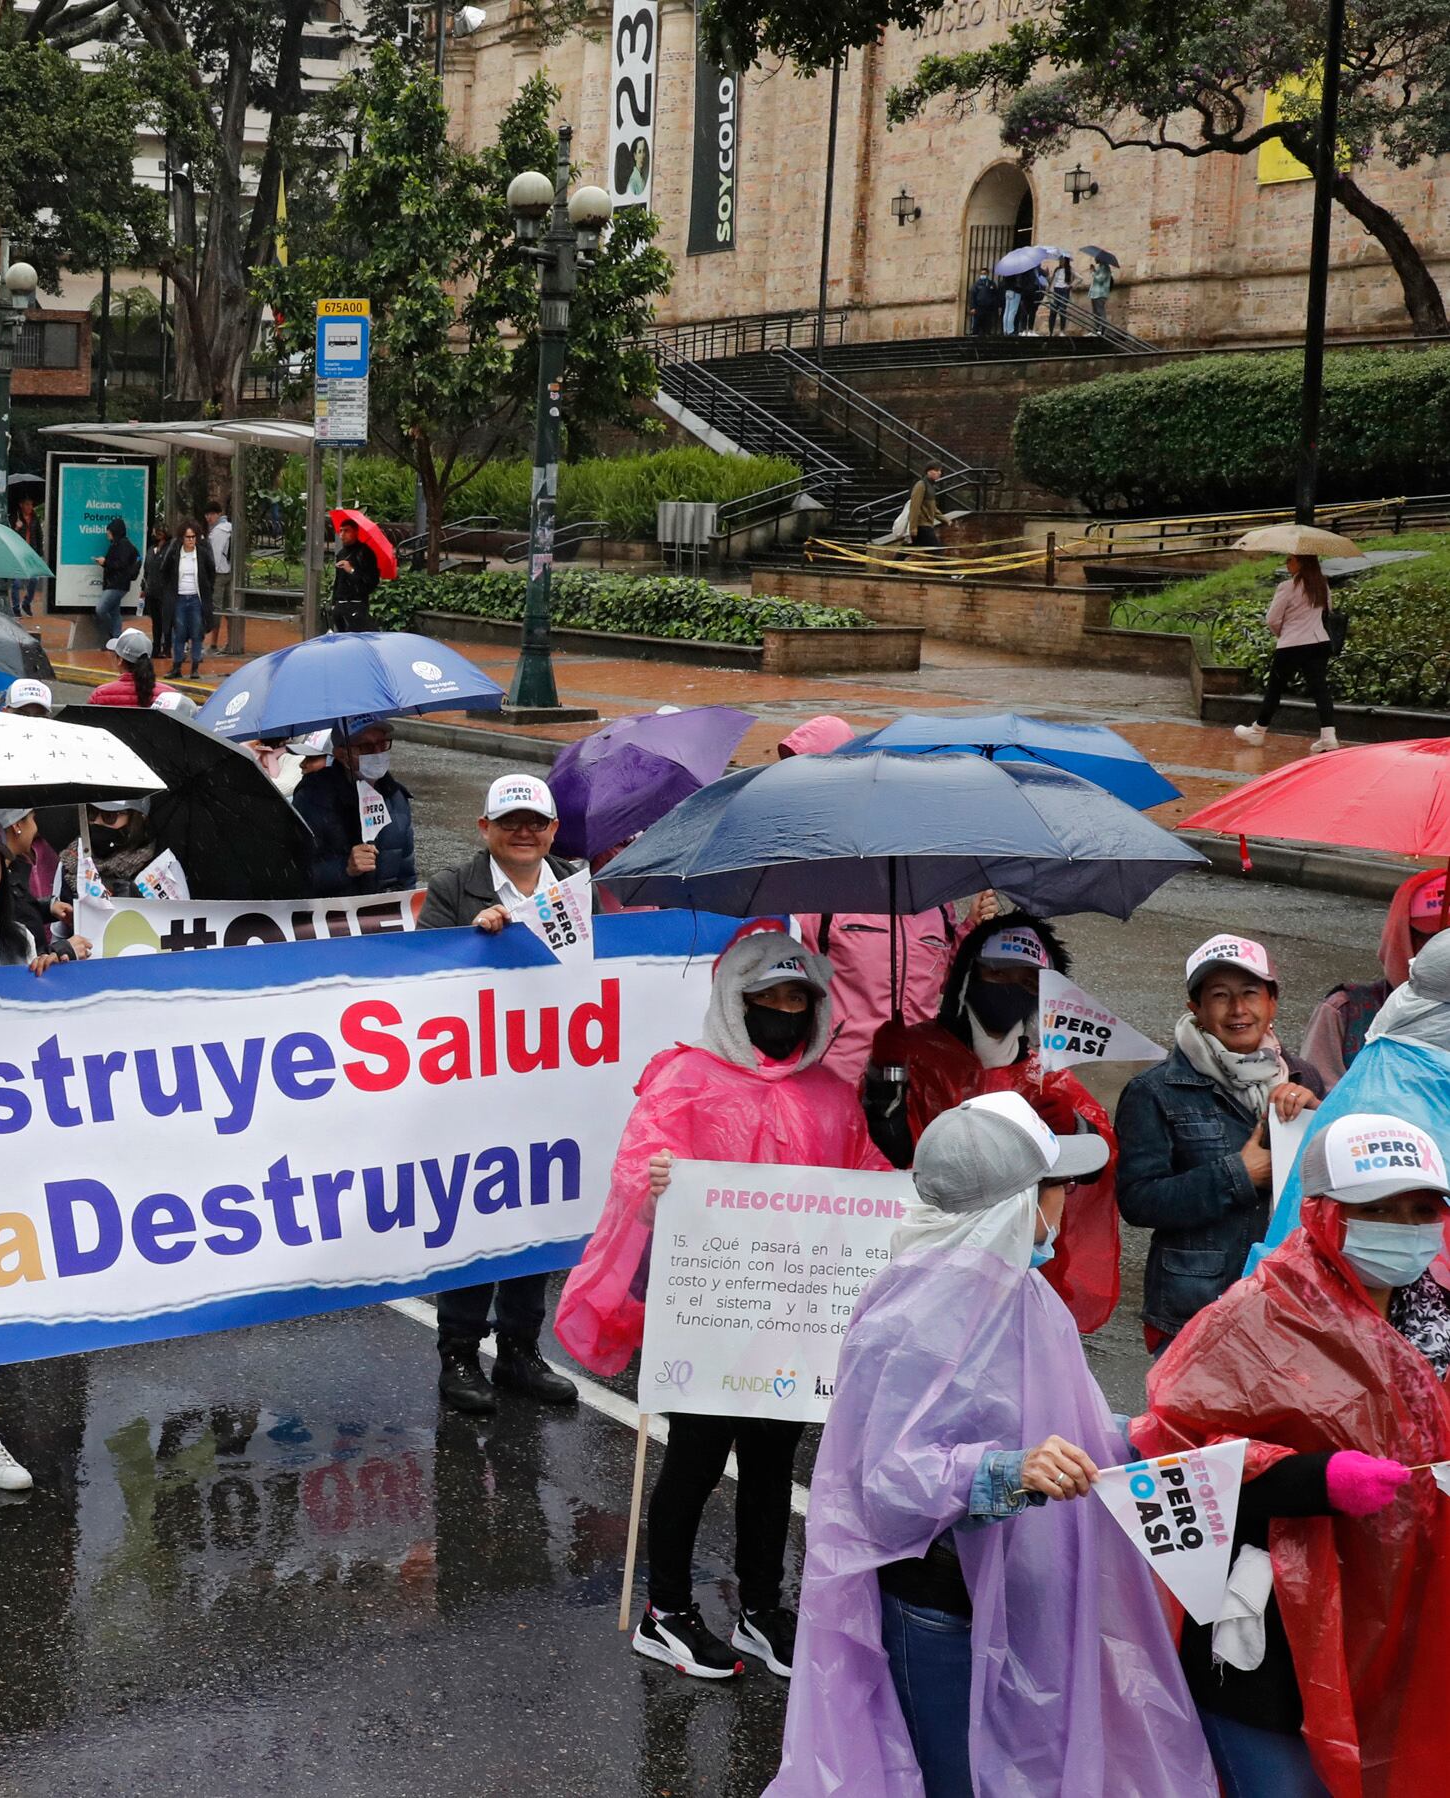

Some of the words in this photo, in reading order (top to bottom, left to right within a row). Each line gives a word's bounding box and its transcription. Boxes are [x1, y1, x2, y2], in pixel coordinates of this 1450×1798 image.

[612, 8, 653, 214] 823
[716, 76, 734, 242] SOYCOLO
[324, 302, 362, 313] 675A00
[85, 500, 122, 510] Alcance
[1045, 999, 1118, 1026] REFORMA
[1347, 1129, 1415, 1144] #REFORMA
[705, 1188, 907, 1219] PREOCUPACIONE
[672, 1233, 689, 1248] 15.
[701, 1236, 740, 1251] ¿Qué
[751, 1240, 801, 1255] pasará
[811, 1245, 828, 1256] en
[841, 1243, 852, 1257] la
[670, 1255, 741, 1271] transición
[747, 1260, 775, 1272] con
[783, 1260, 804, 1274] los
[809, 1262, 877, 1278] pacientes
[668, 1275, 707, 1288] costo
[710, 1278, 721, 1292] y
[725, 1276, 828, 1295] enfermedades
[832, 1282, 861, 1297] hué
[665, 1292, 676, 1306] si
[689, 1294, 703, 1307] el
[716, 1295, 772, 1311] sistema
[785, 1302, 796, 1316] y
[807, 1300, 818, 1314] la
[676, 1311, 753, 1331] funcionan,
[756, 1317, 801, 1333] cómo
[803, 1322, 828, 1334] nos
[830, 1321, 848, 1335] de
